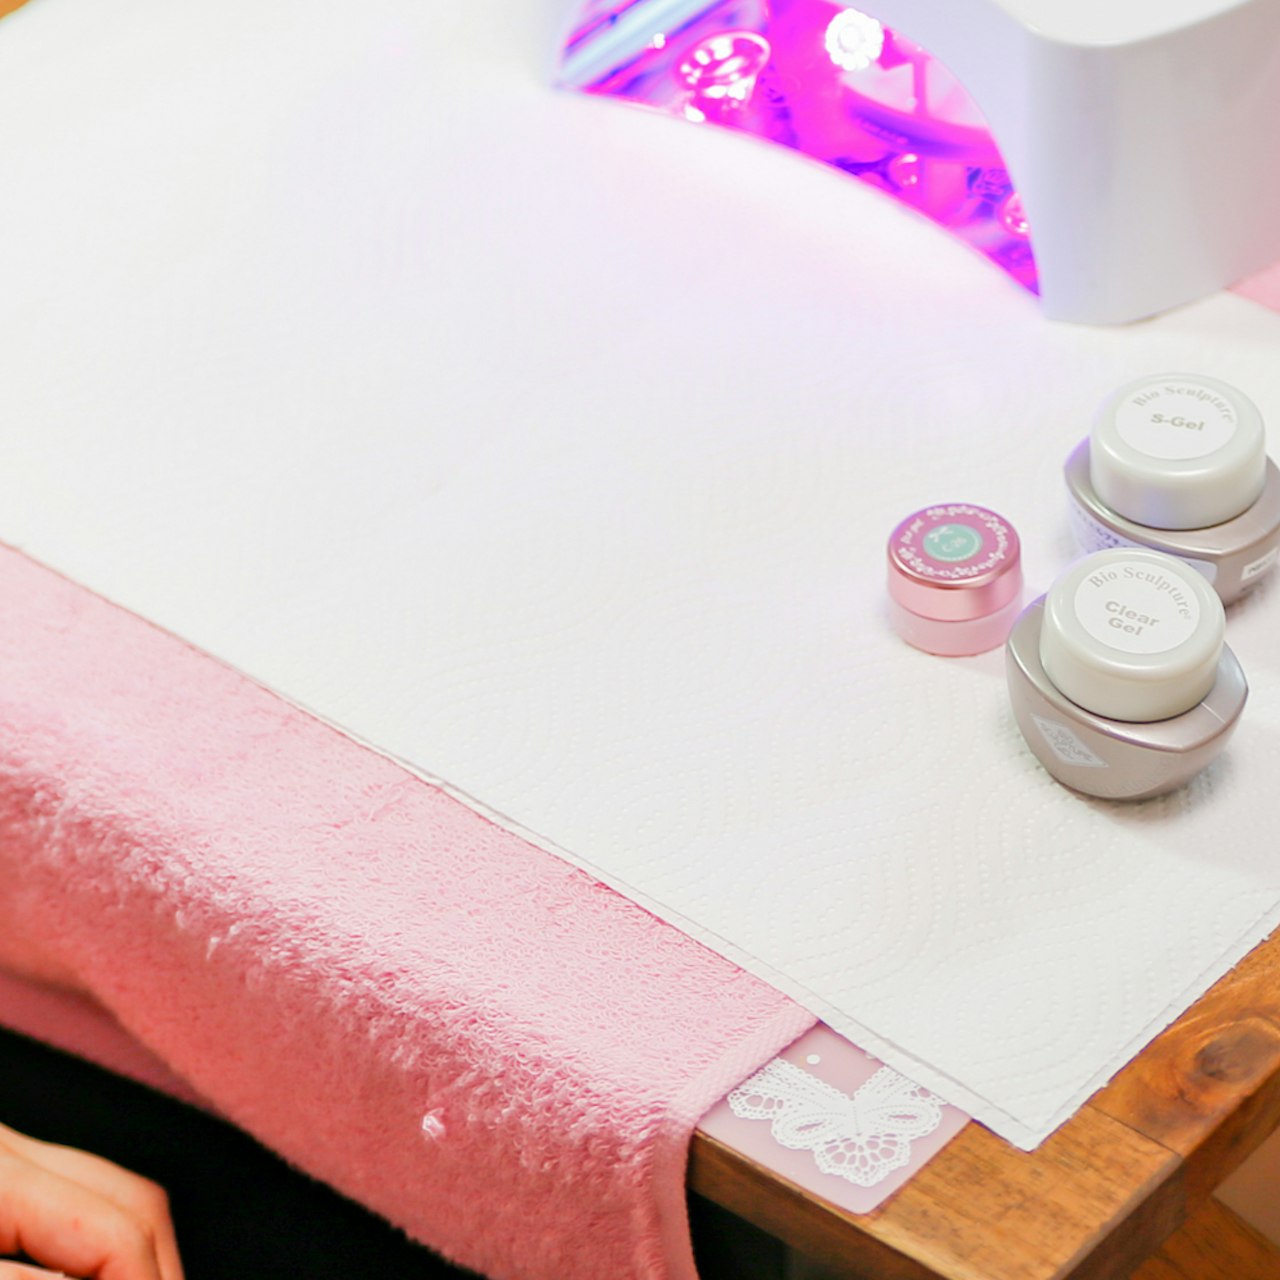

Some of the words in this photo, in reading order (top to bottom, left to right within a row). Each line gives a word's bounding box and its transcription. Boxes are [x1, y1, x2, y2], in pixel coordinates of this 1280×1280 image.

[1132, 390, 1160, 408] Bio
[1150, 413, 1205, 432] S-Gel
[1089, 571, 1118, 589] Bio
[1123, 566, 1191, 617] Sculpture
[1105, 600, 1160, 627] Clear
[1108, 617, 1144, 636] Gel
